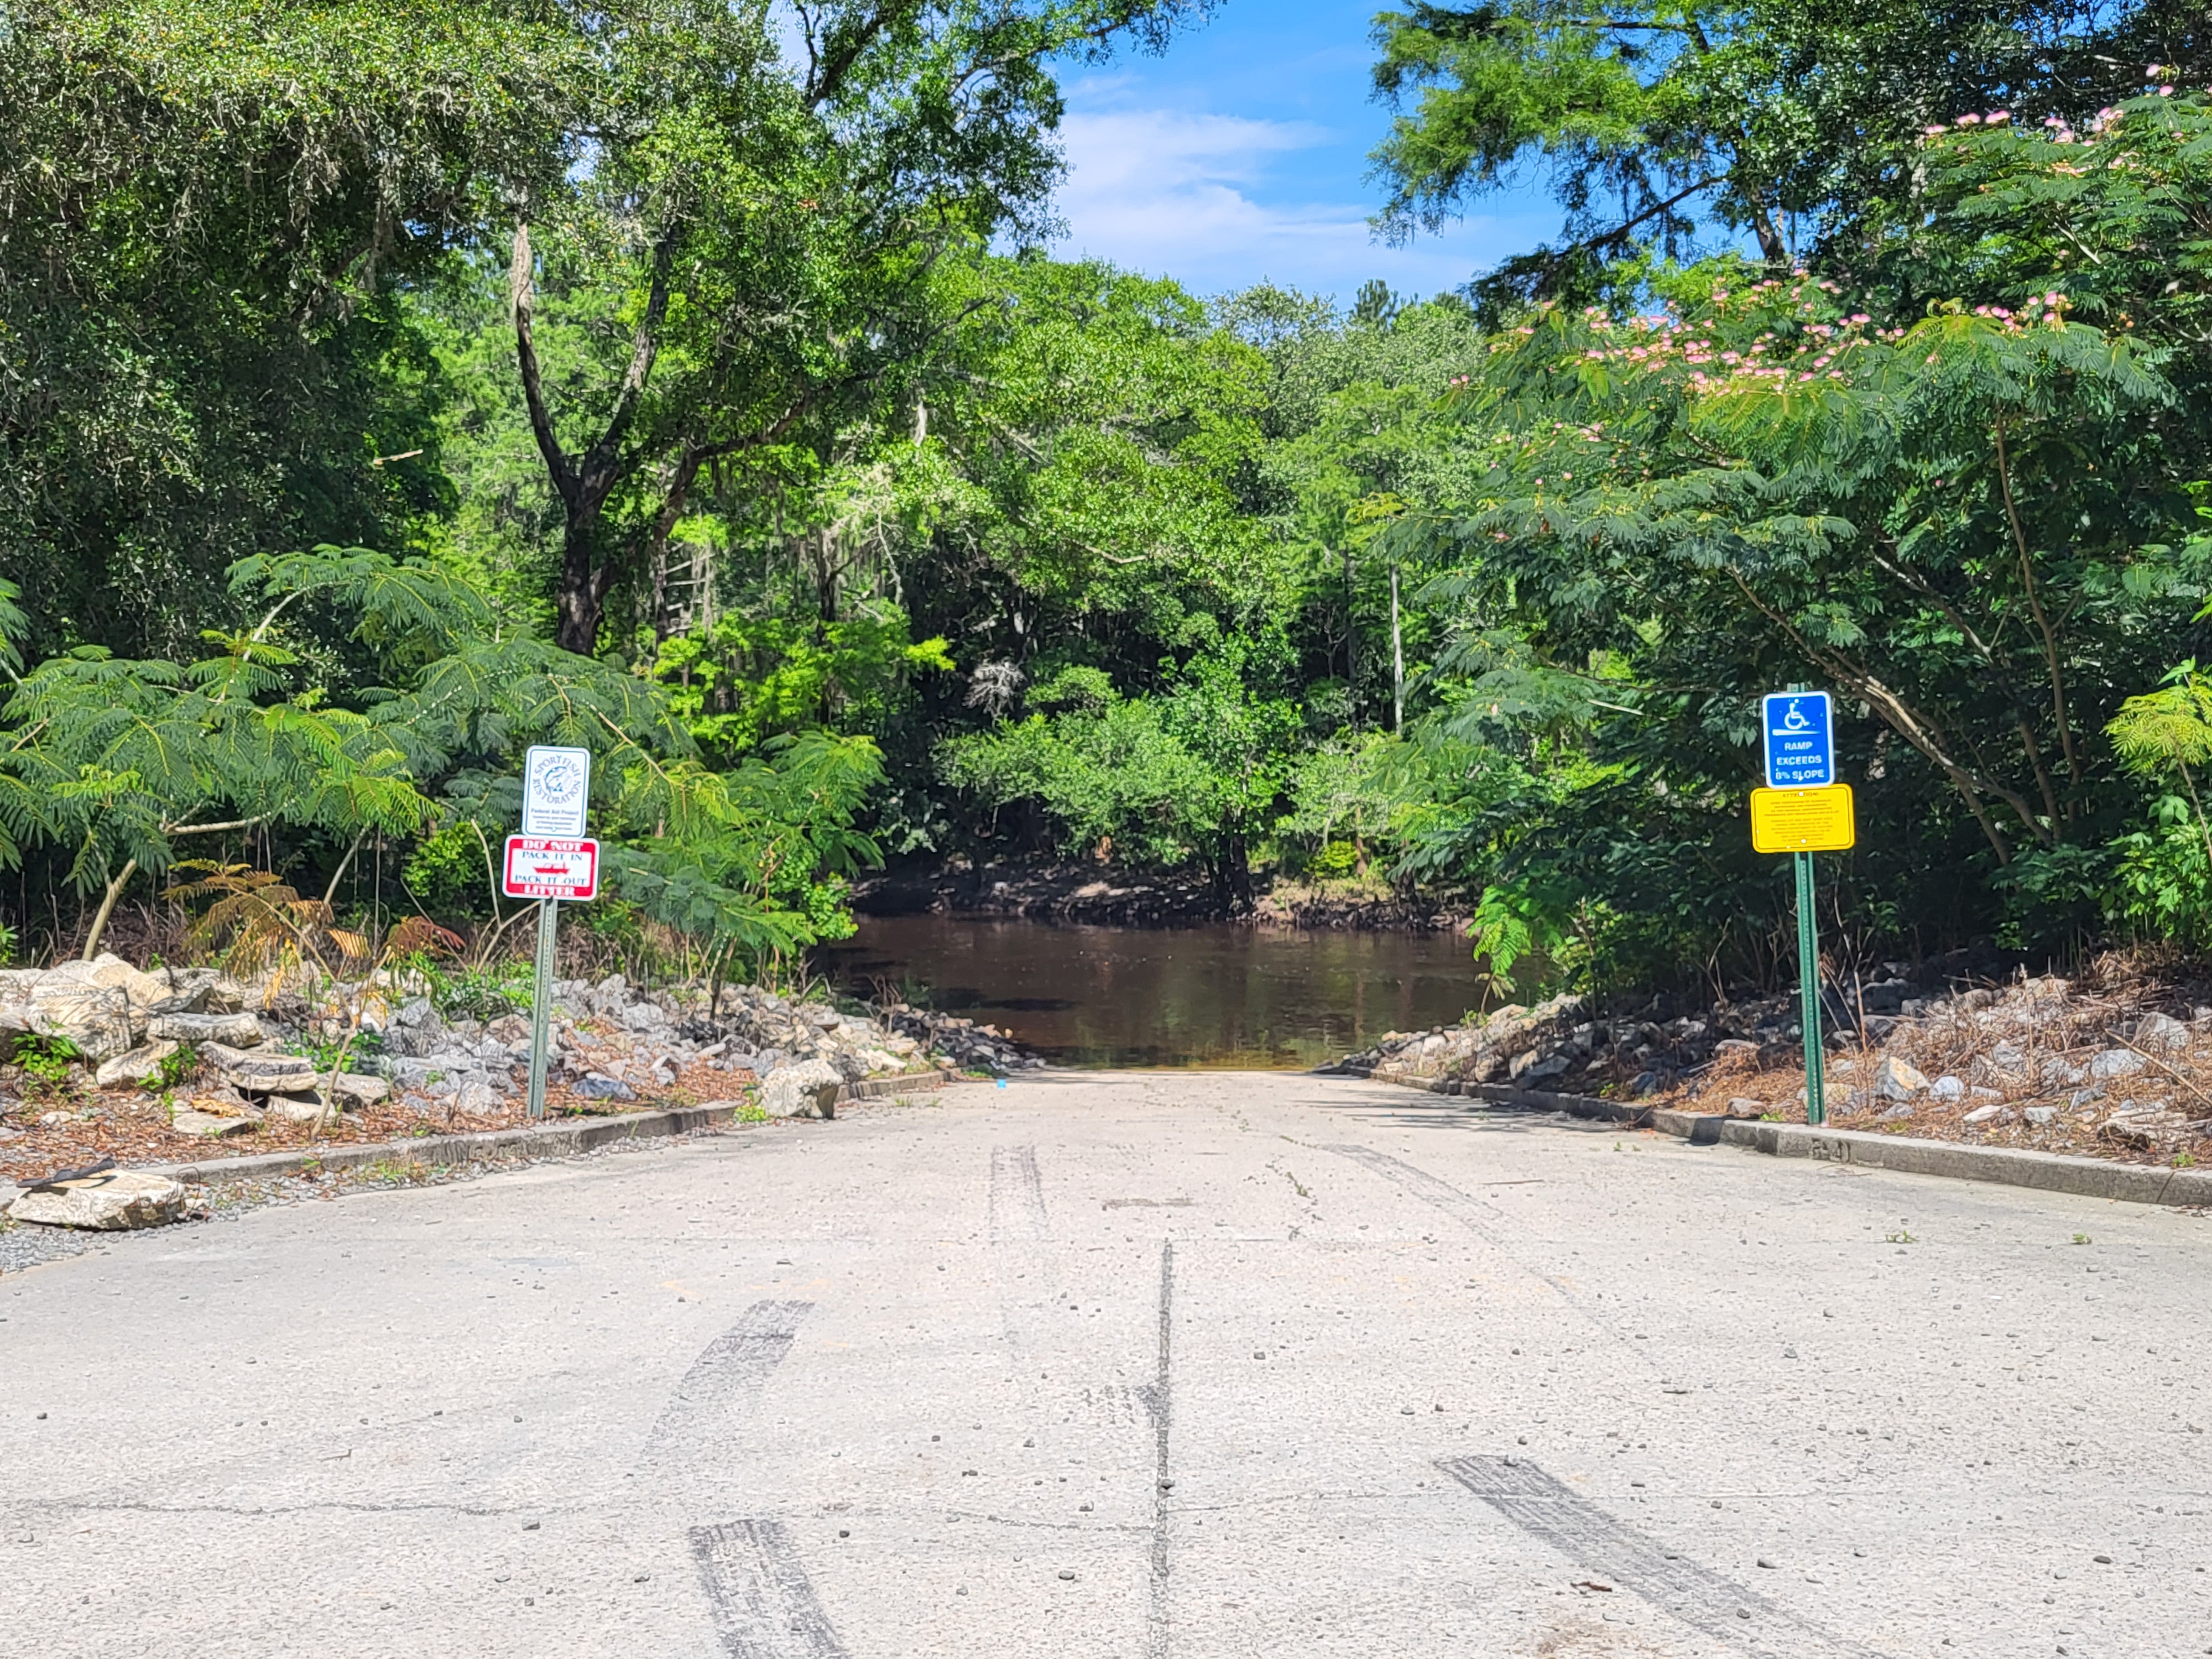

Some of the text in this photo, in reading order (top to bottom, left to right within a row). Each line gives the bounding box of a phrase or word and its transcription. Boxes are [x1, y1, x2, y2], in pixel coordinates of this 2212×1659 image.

[1785, 741, 1813, 751] RAMP
[1776, 755, 1822, 766] EXCEEDS
[1792, 769, 1824, 780] SLOPE
[533, 778, 581, 805] RESTORATION
[523, 839, 583, 852] DO NOT
[522, 851, 549, 859] PACK
[515, 874, 541, 883] PACK
[564, 877, 587, 885] OUT
[524, 885, 575, 896] LITTER
